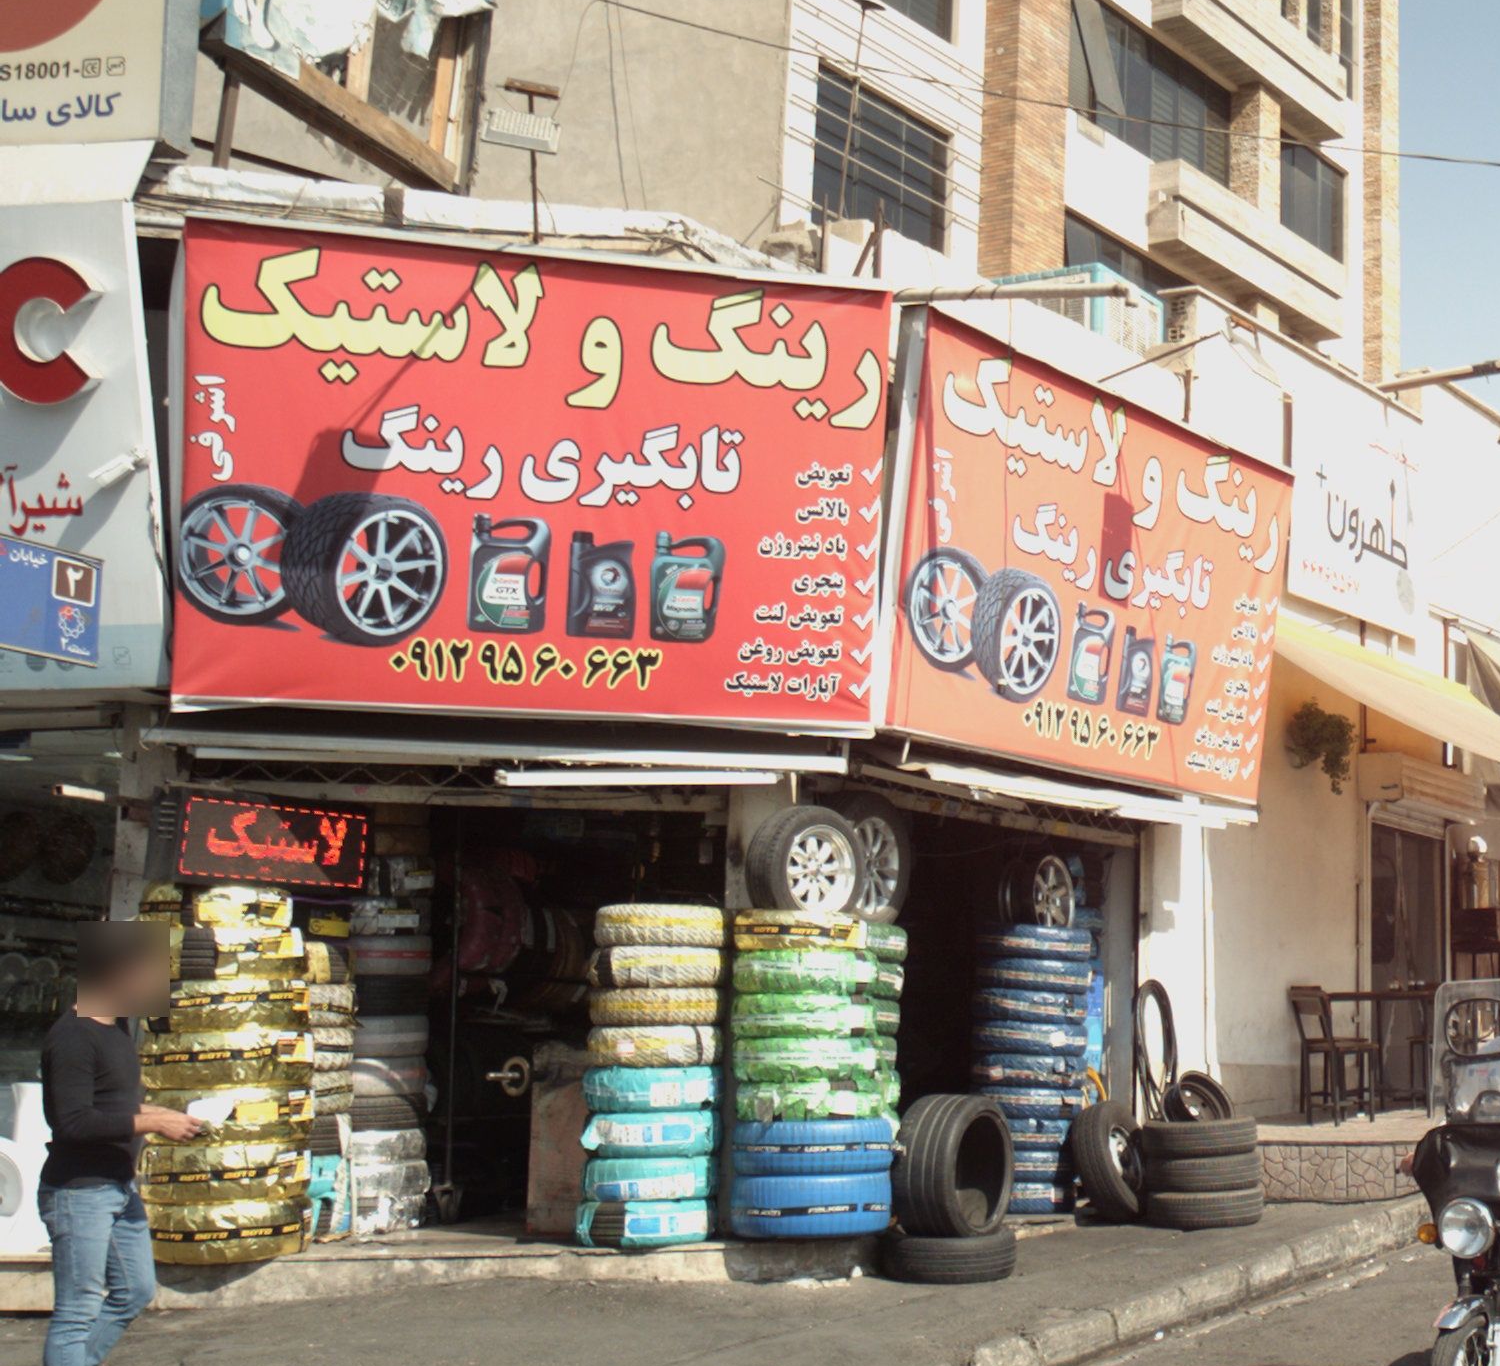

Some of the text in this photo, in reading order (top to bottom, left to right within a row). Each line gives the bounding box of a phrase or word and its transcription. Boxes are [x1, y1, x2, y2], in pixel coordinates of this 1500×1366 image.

[46, 92, 122, 127] کالای
[201, 248, 883, 429] رینگ و لاستیک
[341, 405, 744, 509] تابگیری رینگ
[941, 358, 1279, 573] رینگ و لاستیک
[797, 463, 852, 489] تعویض
[797, 500, 848, 524] بالانس
[1327, 479, 1408, 570] طهرون
[9, 546, 48, 568] خیابان
[823, 536, 846, 558] باد
[1012, 503, 1096, 591] رینگ
[66, 566, 84, 597] ۲
[794, 573, 844, 596] پنچری
[1103, 549, 1213, 618] تابگیری
[755, 605, 842, 630] تعویض لنت
[390, 638, 663, 690] ۰۹۱۲ ۹۵ ۶۰ ۶۶۳
[739, 642, 840, 666] تعویض روغن
[726, 674, 782, 698] لاستیک
[1024, 699, 1067, 736] ۰۹۱۲
[207, 810, 347, 873] لاستیک
